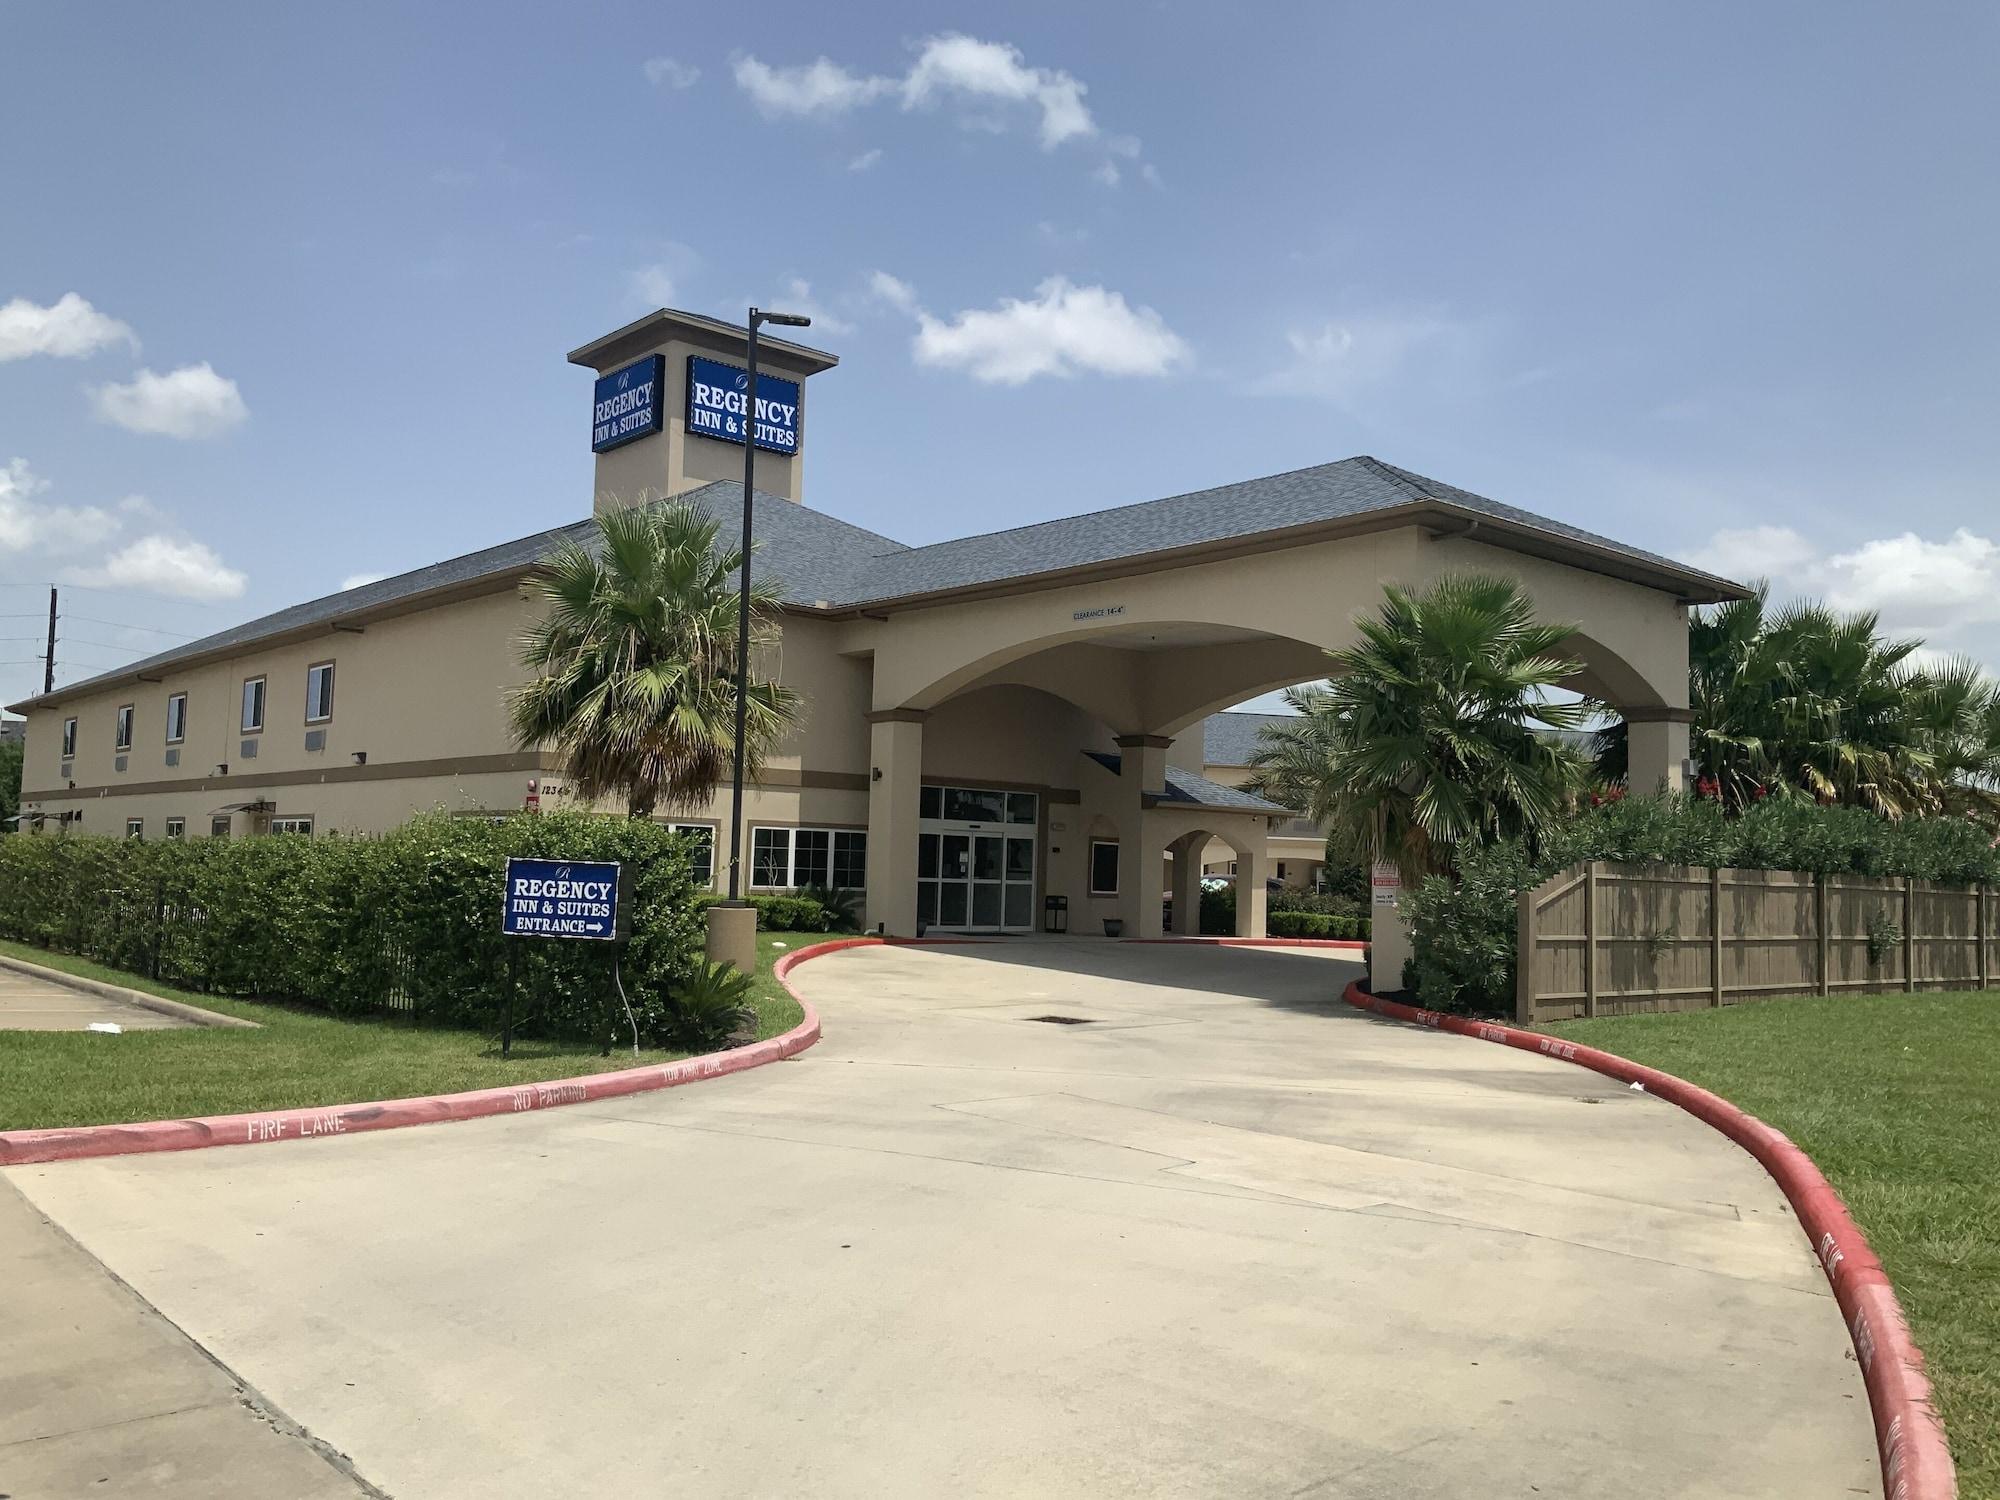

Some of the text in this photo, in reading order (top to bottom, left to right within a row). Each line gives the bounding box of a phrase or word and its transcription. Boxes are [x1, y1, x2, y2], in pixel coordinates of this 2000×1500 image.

[595, 381, 653, 424] REGENCY
[694, 382, 795, 426] REGENCY
[594, 407, 652, 444] INN & SUITES
[694, 408, 721, 430] INN
[726, 416, 738, 434] &
[1073, 608, 1104, 620] CLEARANCE
[513, 878, 612, 900] REGENCY
[512, 899, 610, 917] INN & SUITES
[516, 916, 586, 933] ENTRANCE
[514, 1084, 586, 1111] NO PARKING
[300, 1112, 346, 1135] LANE
